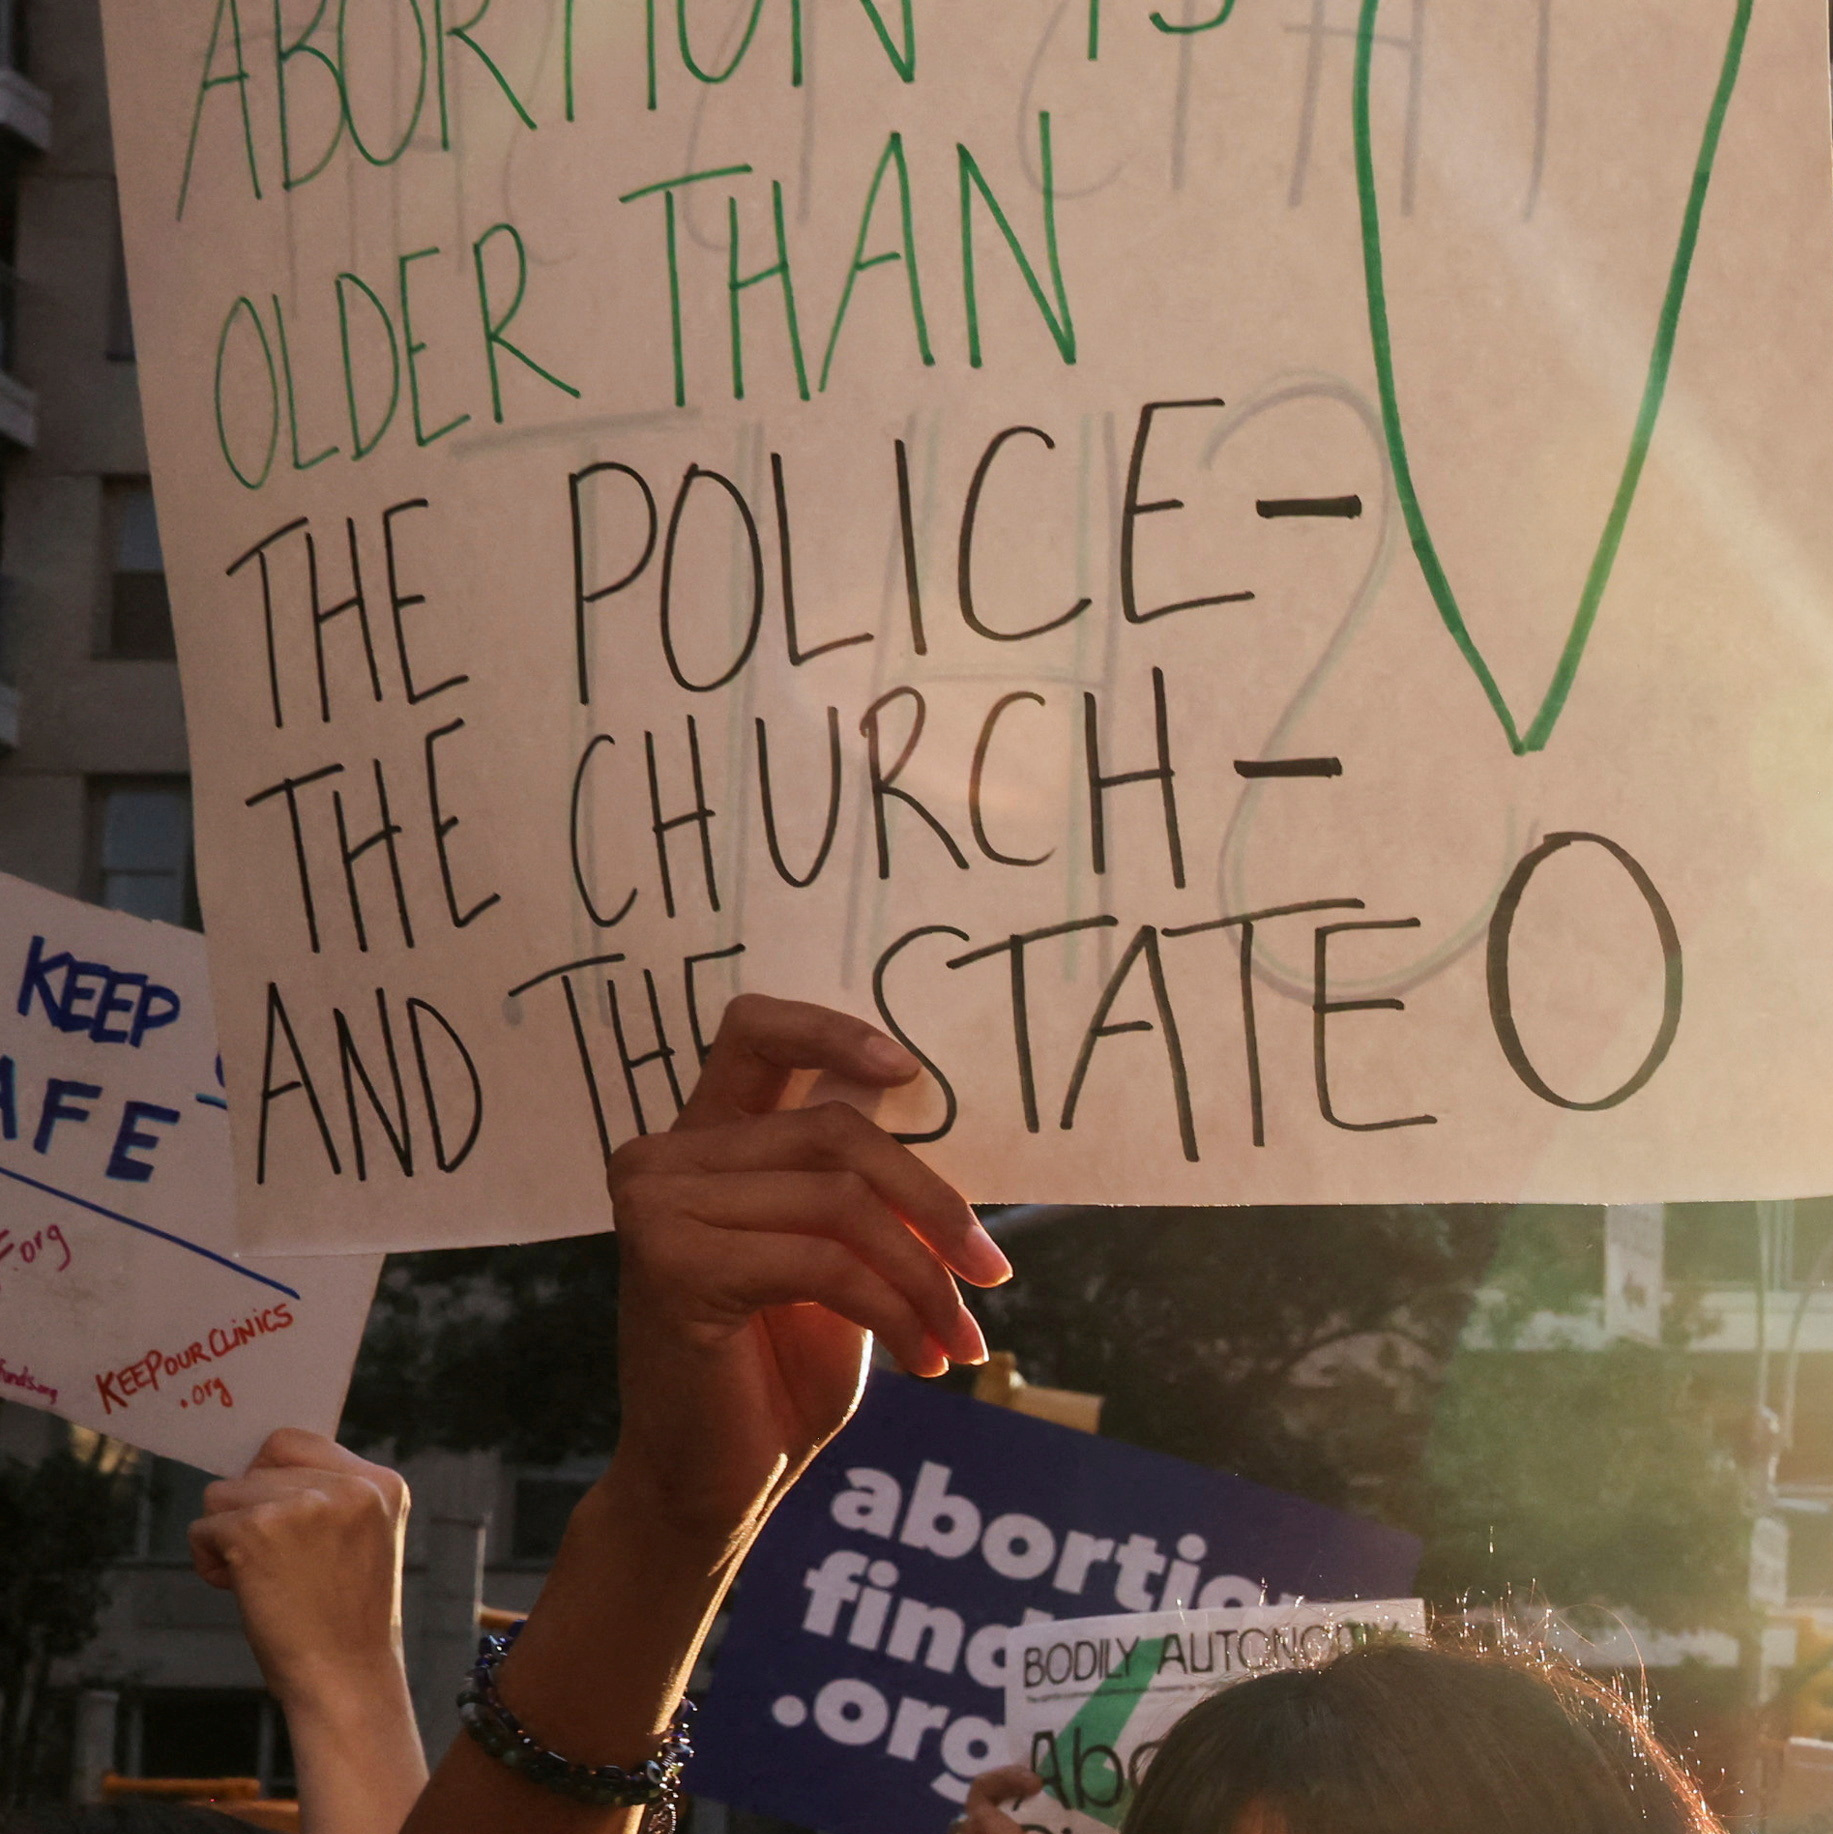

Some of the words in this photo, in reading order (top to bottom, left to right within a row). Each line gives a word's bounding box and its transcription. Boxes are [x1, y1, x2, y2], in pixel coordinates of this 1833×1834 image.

[215, 224, 580, 490] OLDER
[620, 132, 1076, 407] THAN
[226, 498, 470, 728] THE
[245, 718, 500, 953] THE
[17, 935, 181, 1048] KEEP
[257, 982, 483, 1184] AND
[873, 898, 1437, 1161] STATE
[0, 1055, 181, 1184] FE
[180, 1376, 233, 1408] .org
[829, 1459, 1302, 1612] aborti
[1023, 1637, 1141, 1688] BODILY
[1157, 1618, 1398, 1675] AUTONO
